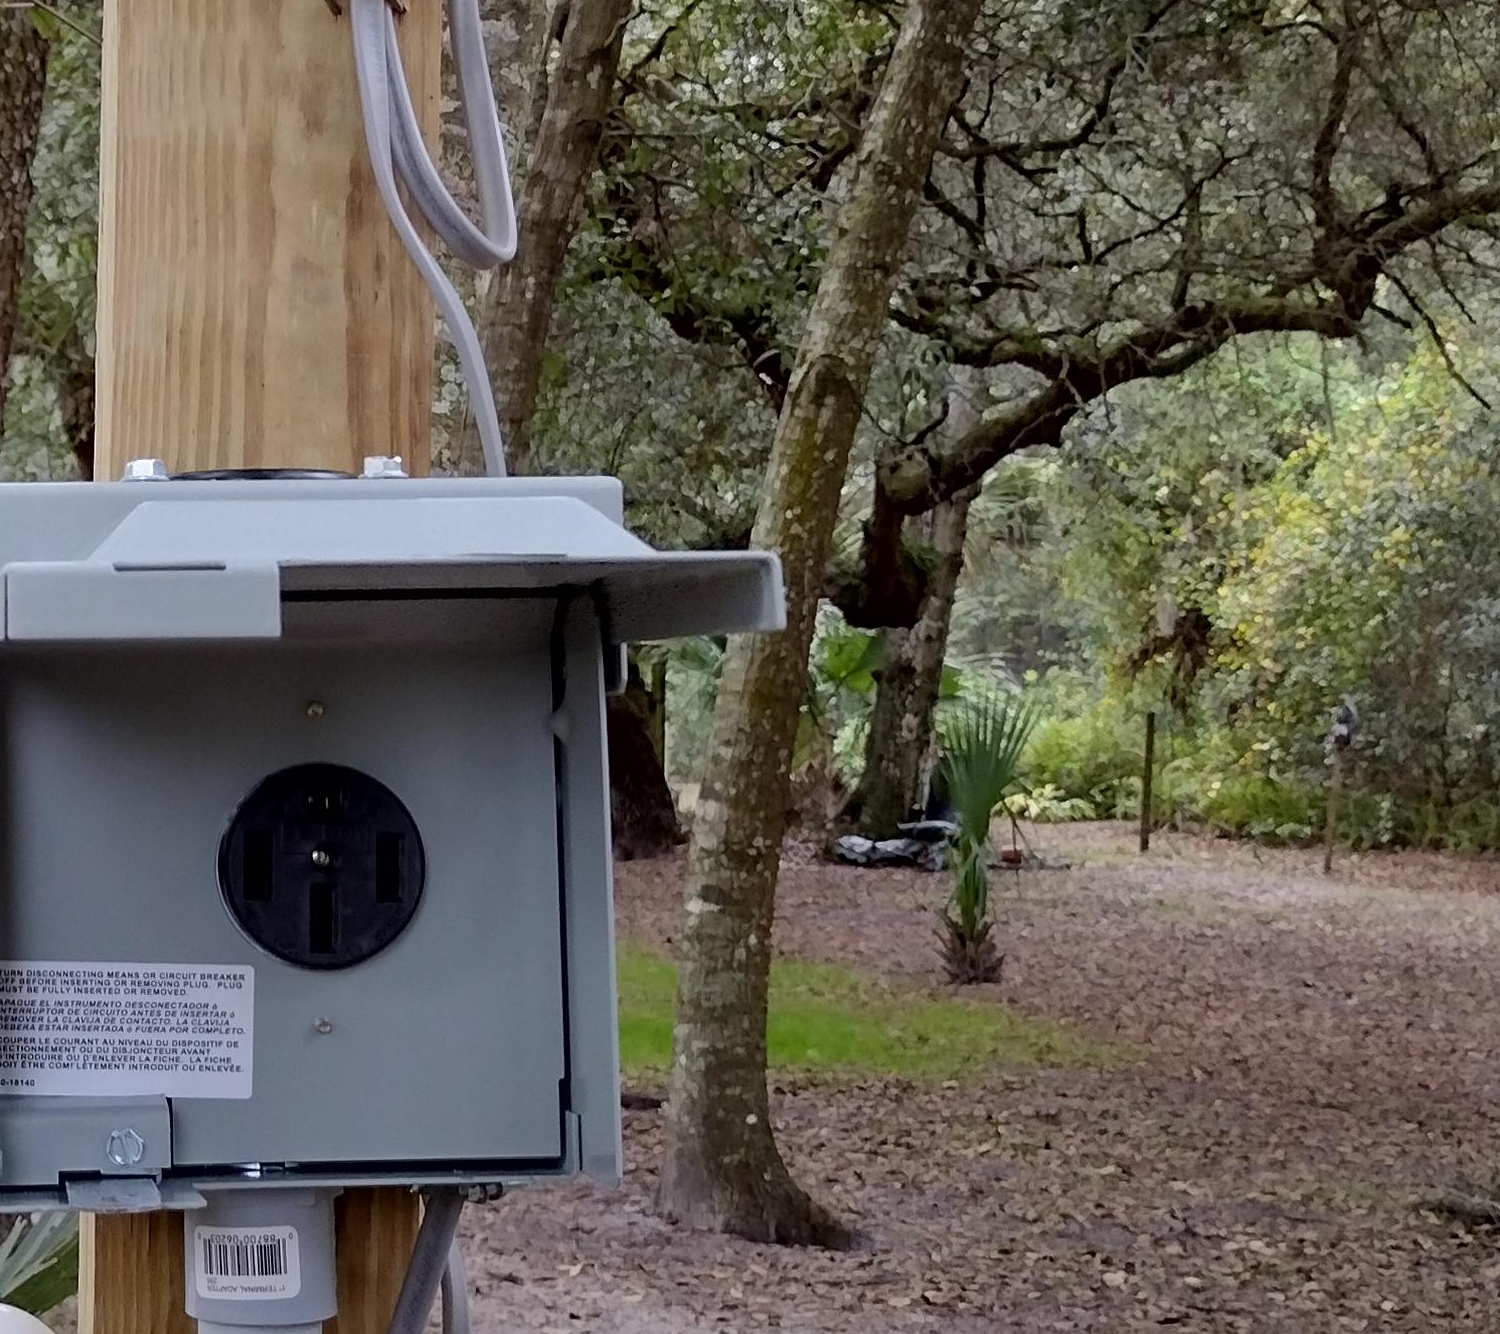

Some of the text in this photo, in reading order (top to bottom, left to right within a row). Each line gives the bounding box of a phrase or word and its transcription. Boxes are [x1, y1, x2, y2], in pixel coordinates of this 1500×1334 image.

[26, 970, 103, 978] DISCONNECTING
[160, 972, 196, 980] CIRCUIT
[200, 973, 245, 981] BREAKER
[19, 978, 57, 986] BEFORE
[217, 981, 242, 989] PLUG
[74, 987, 120, 995] INSERTED
[140, 988, 188, 996] REMOVED.
[54, 1000, 121, 1008] INSTRUMENTO
[125, 1001, 209, 1009] DESCONECTADOR
[83, 1008, 128, 1016] CIRCUITO
[62, 1016, 100, 1024] CLAVIJA
[119, 1017, 172, 1025] CONTACTO.
[72, 1025, 124, 1033] INSERTADA
[192, 1027, 245, 1035] COMPLETO.
[39, 1037, 50, 1045] LE
[53, 1037, 99, 1045] COURANT
[113, 1047, 177, 1055] DISJONCTEUR
[182, 1064, 195, 1072] OU
[210, 1233, 239, 1244] 06203
[244, 1233, 276, 1244] 88700
[207, 1284, 238, 1293] ADAPTER
[240, 1285, 278, 1293] TERMINAL
